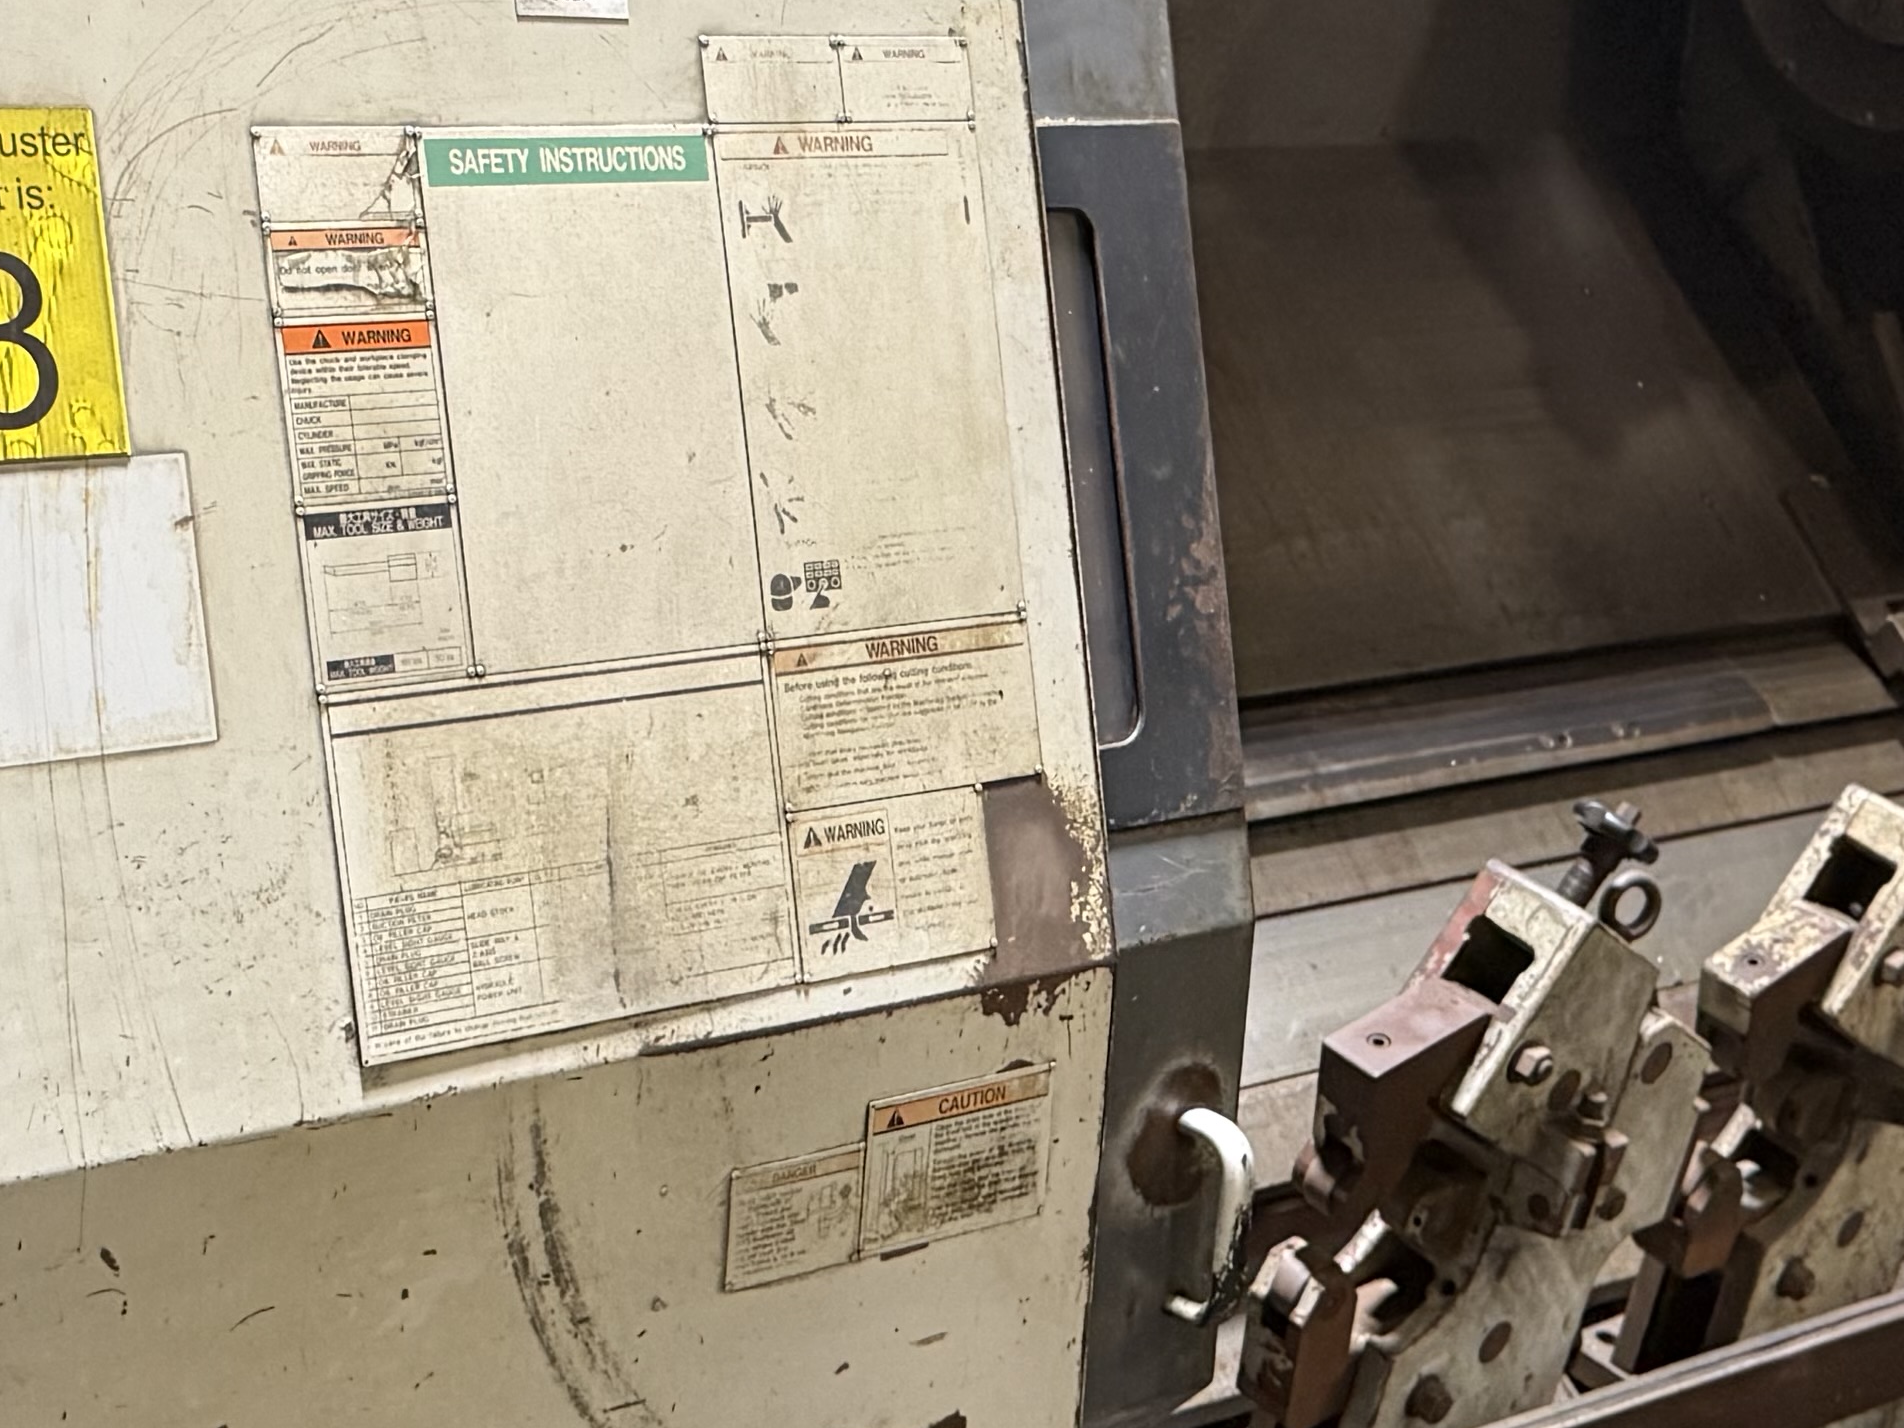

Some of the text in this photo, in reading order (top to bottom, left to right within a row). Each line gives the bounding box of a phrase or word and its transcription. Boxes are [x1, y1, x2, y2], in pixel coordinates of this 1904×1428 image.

[882, 49, 925, 59] WARNING
[309, 140, 362, 152] WARNING
[798, 135, 873, 153] WARNING
[449, 145, 686, 175] SAFETY INSTRUCTIONS
[17, 176, 55, 211] is:
[325, 232, 385, 247] WARNING
[315, 265, 337, 276] open
[341, 328, 412, 346] WARNING
[341, 523, 368, 536] TOOL
[371, 521, 394, 533] SIZE
[408, 516, 444, 530] WEIGHT
[865, 635, 938, 660] WARNING
[784, 681, 813, 694] Before
[815, 677, 839, 691] using
[842, 675, 856, 686] the
[824, 818, 885, 844] WARNING
[938, 1085, 1007, 1115] CAUTION
